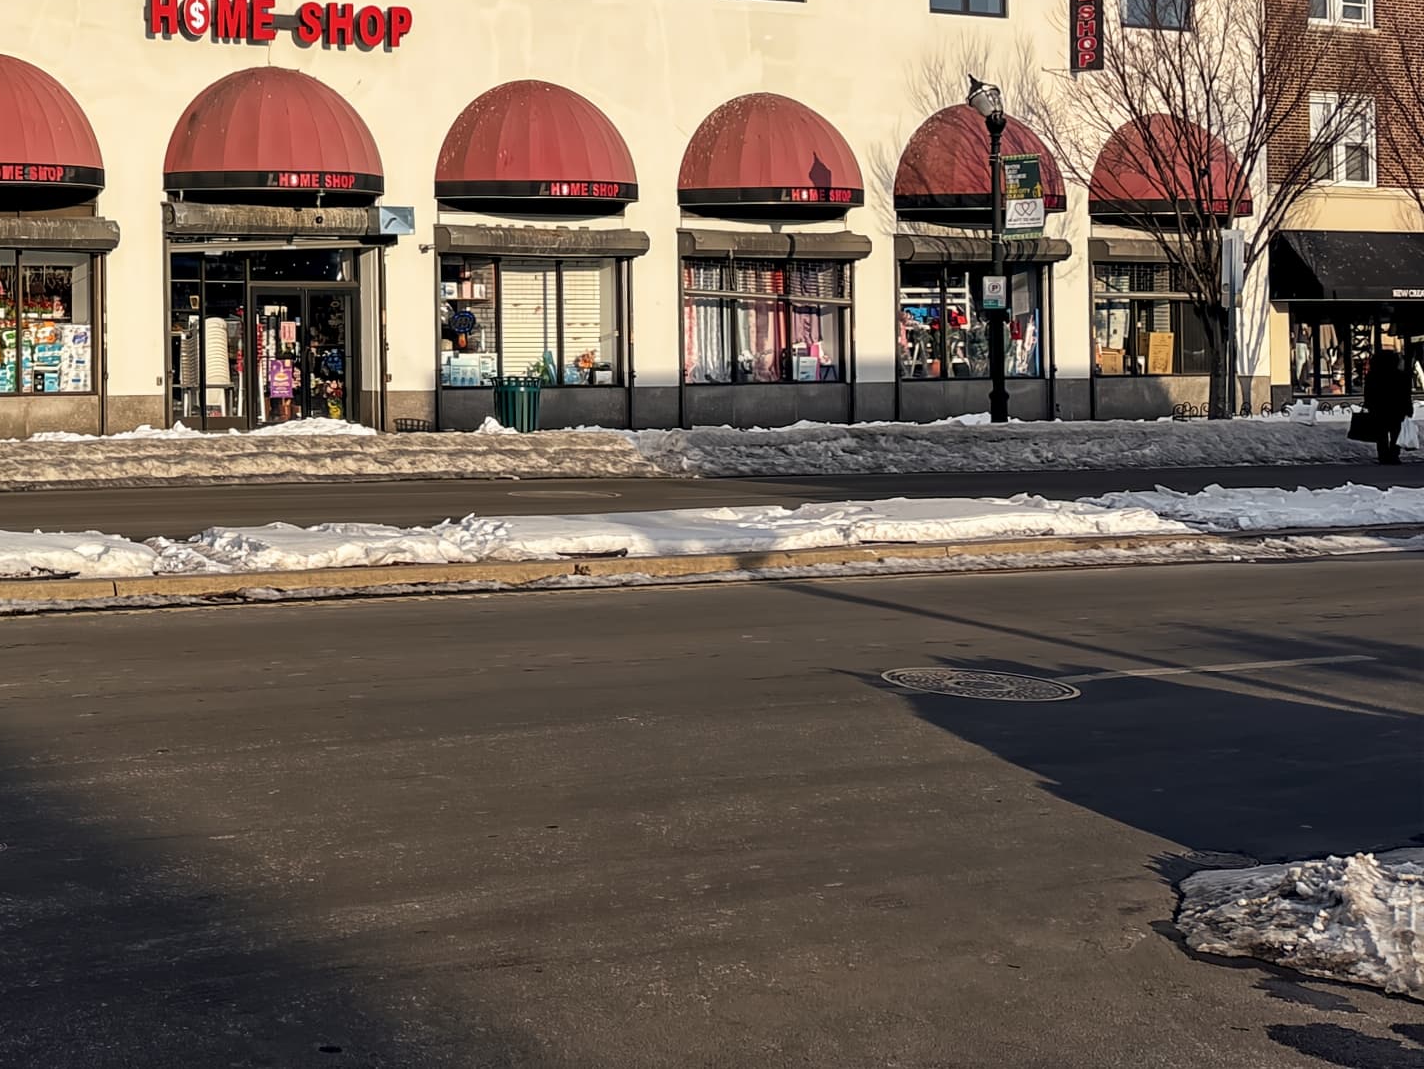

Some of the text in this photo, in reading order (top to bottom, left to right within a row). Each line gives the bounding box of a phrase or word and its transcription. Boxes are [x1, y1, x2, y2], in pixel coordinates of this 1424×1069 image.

[297, 1, 413, 48] SHOP
[1077, 4, 1097, 67] SHOP
[29, 165, 64, 182] SHOP
[278, 172, 320, 187] HOME
[324, 173, 355, 189] SHOP
[550, 182, 589, 196] HOME
[592, 182, 619, 197] SHOP
[829, 189, 852, 202] SHOP
